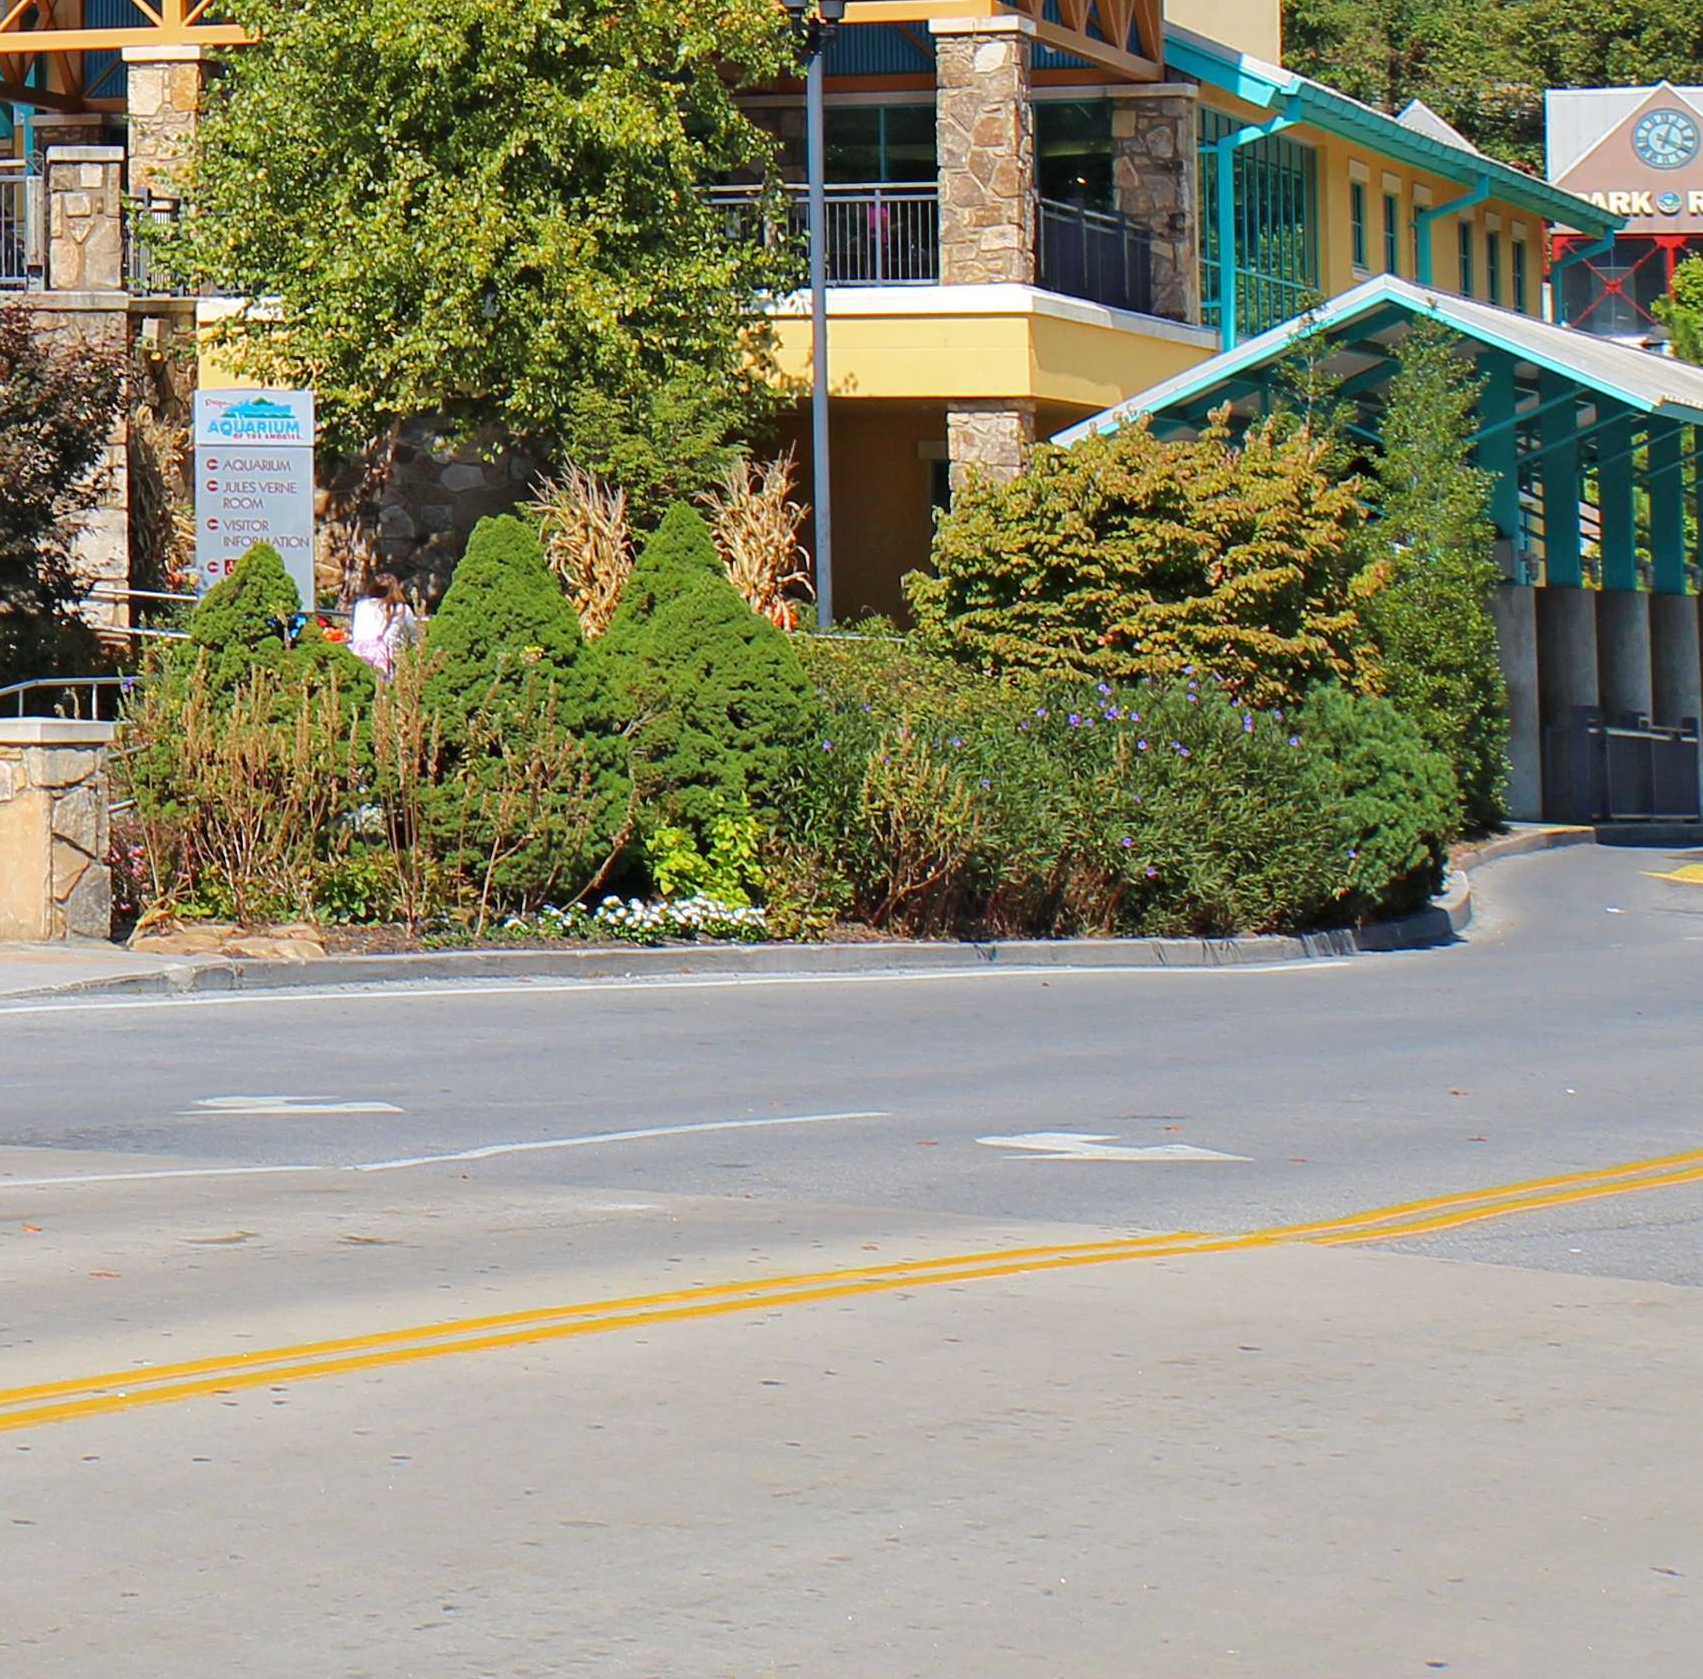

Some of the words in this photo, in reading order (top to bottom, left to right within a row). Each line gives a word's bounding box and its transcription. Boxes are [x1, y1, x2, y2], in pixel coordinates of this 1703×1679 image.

[207, 421, 300, 436] AQUARIUM
[222, 459, 291, 472] AQUARIUM
[223, 482, 256, 494] JULES
[258, 482, 297, 494] VERNE
[223, 497, 263, 509] ROOM
[223, 520, 269, 531] VISITOR
